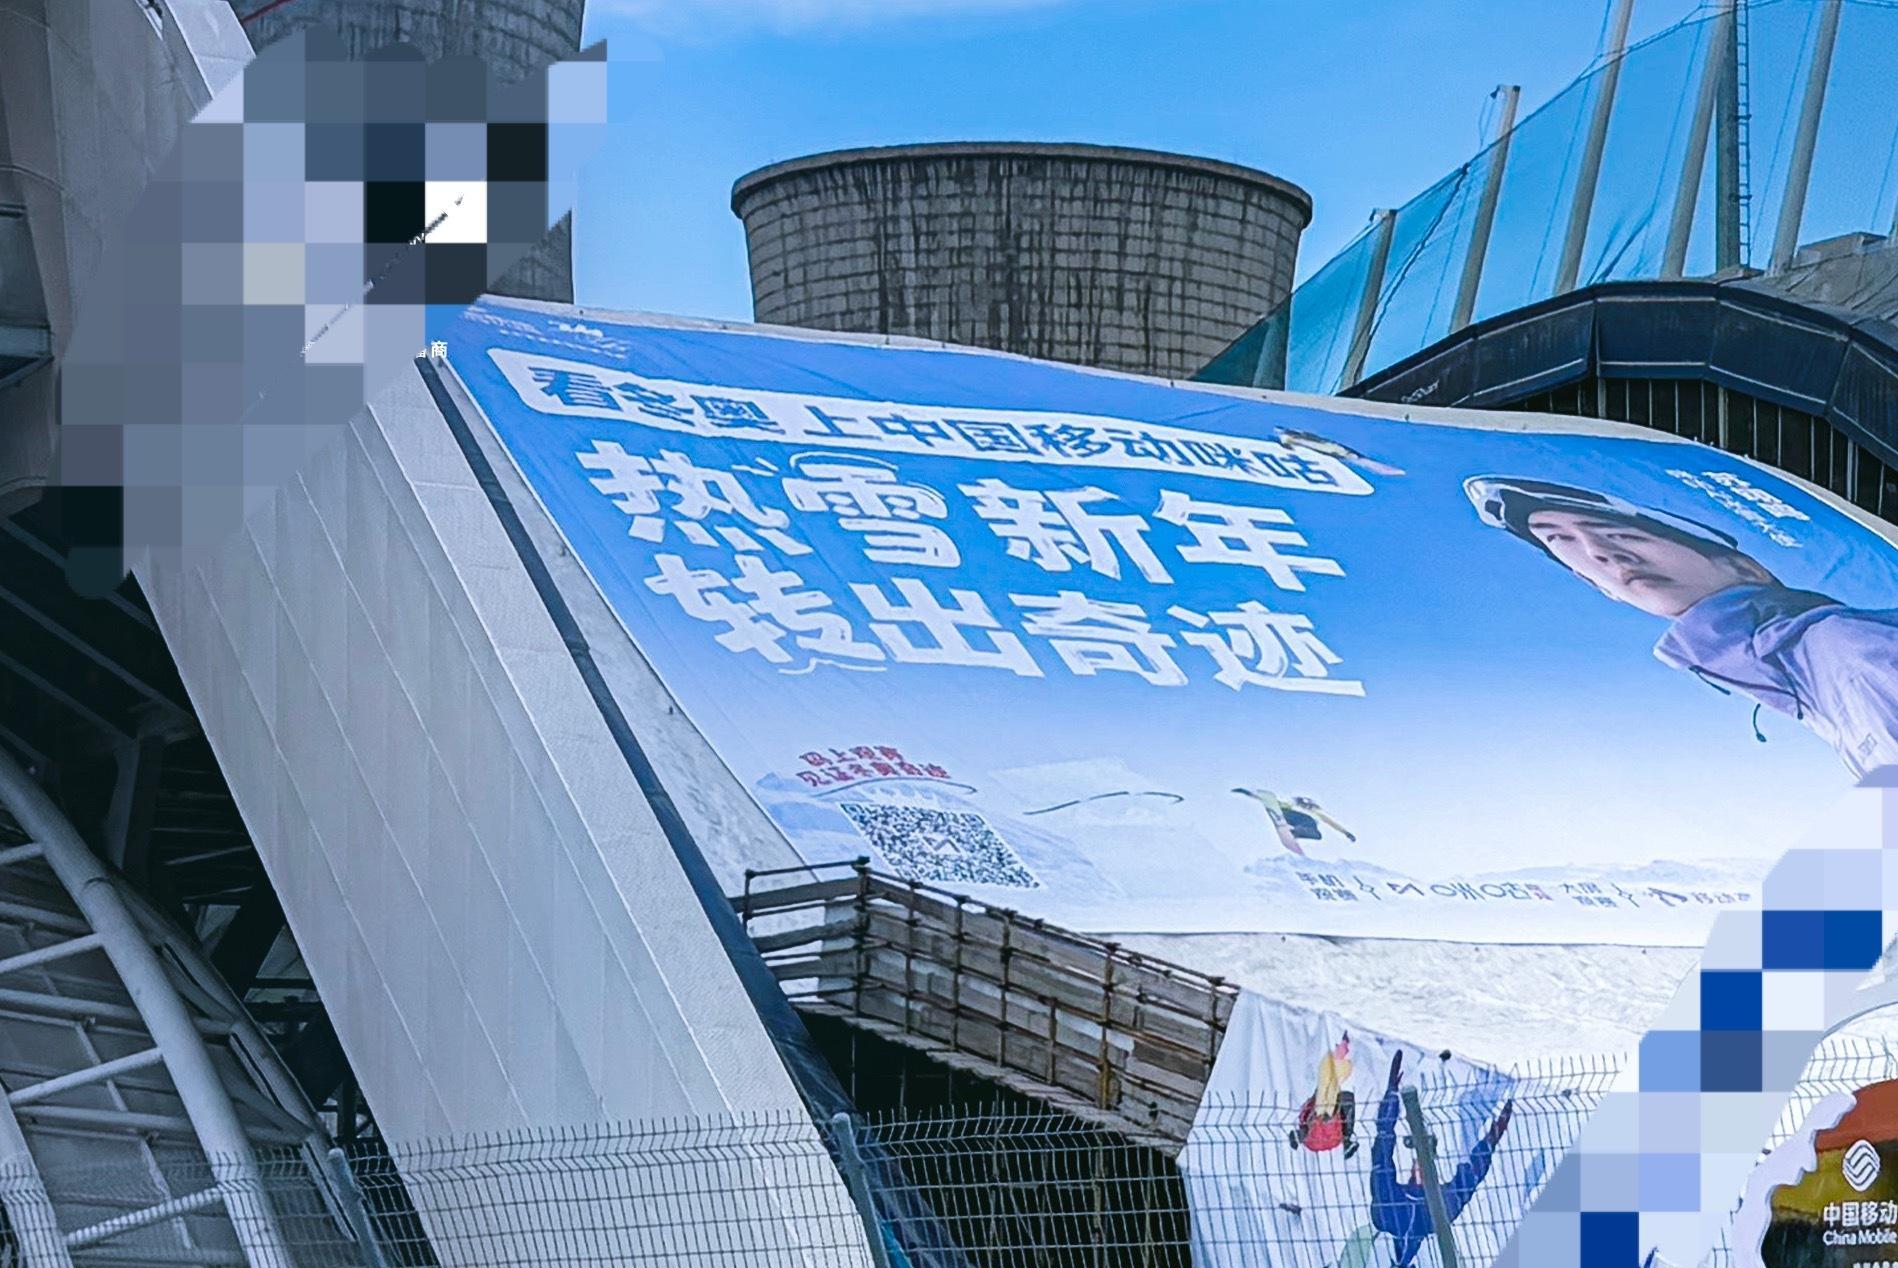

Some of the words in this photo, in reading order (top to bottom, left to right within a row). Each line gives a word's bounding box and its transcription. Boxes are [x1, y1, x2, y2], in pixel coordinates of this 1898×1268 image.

[531, 366, 782, 435] 看冬奥
[804, 405, 1335, 488] 上中国移动咪咕
[576, 439, 1345, 591] 热雪新年
[645, 553, 1367, 699] 转出奇迹
[1822, 1229, 1857, 1246] China
[1858, 1227, 1897, 1245] Mobile
[1823, 1201, 1898, 1227] 中国移动
